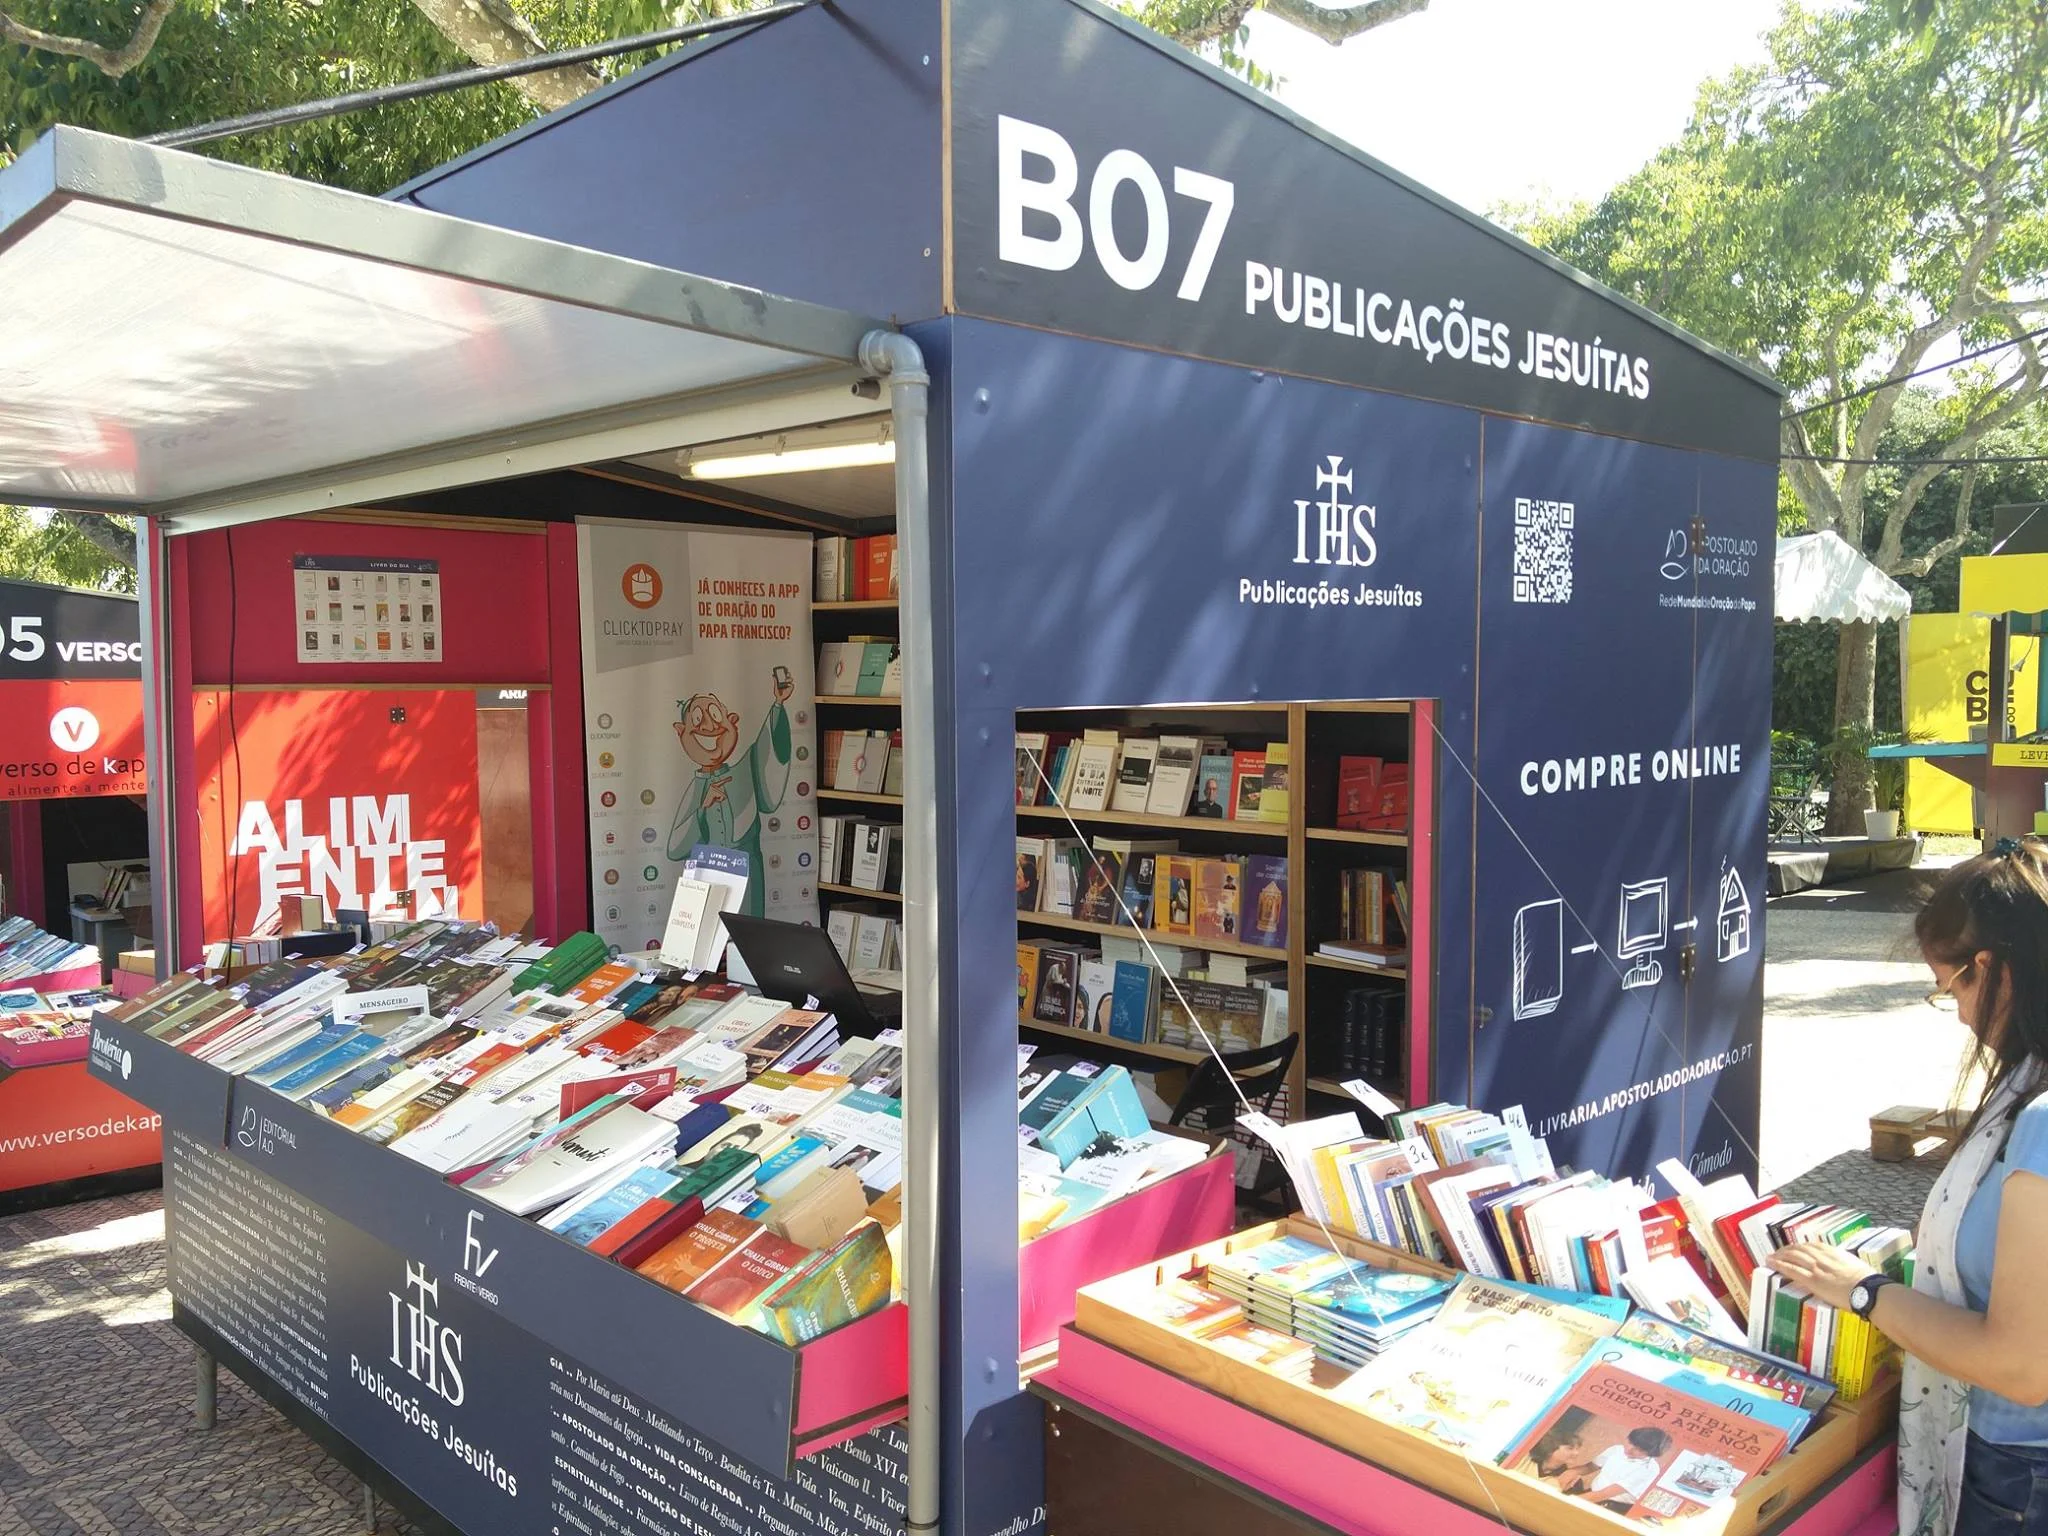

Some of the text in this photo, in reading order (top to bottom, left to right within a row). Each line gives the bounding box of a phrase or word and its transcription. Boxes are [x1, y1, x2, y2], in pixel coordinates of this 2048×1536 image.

[997, 114, 1236, 303] B07
[1245, 261, 1652, 401] PUBLICAÇÕES JESUÍTAS
[1292, 499, 1377, 567] IHS
[1702, 535, 1757, 557] POSTOLADO
[1712, 556, 1750, 579] ORAÇÃO
[697, 577, 800, 598] JÁ CONHECES A APP
[1239, 578, 1423, 609] Publicações Jesuítas
[699, 601, 775, 620] DE ORAÇÃO DO
[603, 619, 684, 637] CLICKTOPRAY
[699, 623, 791, 640] PAPA FRANCISCO?
[66, 755, 96, 775] de
[103, 757, 145, 778] kap
[1520, 744, 1741, 796] COMPRE ONLINE
[8, 782, 145, 796] alimente a mente
[360, 996, 409, 1009] MENSAGEIRO
[263, 1117, 297, 1150] EDITORIAL
[1689, 1140, 1733, 1178] Cómodo
[741, 1261, 775, 1280] O LOUCO
[742, 1248, 791, 1274] KHALIL GIBRAN
[454, 1272, 499, 1306] FRENTE VERSO
[1467, 1293, 1522, 1316] DE JESUS
[1471, 1285, 1553, 1317] O NASCIMENTO
[280, 1320, 320, 1357] ESPIRITUALIDADE
[389, 1291, 465, 1407] IHS
[1589, 1384, 1667, 1420] CHEGOU
[1603, 1378, 1760, 1444] COMO A BÍBLIA
[350, 1353, 518, 1498] Publicações Jesuítas
[550, 1357, 564, 1372] GIA
[588, 1376, 610, 1400] Maria
[611, 1391, 622, 1406] até
[622, 1396, 640, 1418] Deus
[646, 1410, 685, 1445] Meditando
[693, 1437, 714, 1462] Terço
[720, 1454, 751, 1486] Bendita
[752, 1474, 761, 1491] és
[763, 1479, 776, 1500] Tu
[782, 1491, 814, 1525] Maria,
[817, 1512, 839, 1536] Mãe
[574, 1392, 613, 1428] Documentos
[613, 1417, 623, 1432] da
[623, 1422, 644, 1446] Igreja
[654, 1444, 676, 1466] VIDA
[678, 1459, 744, 1508] CONSAGRADA
[845, 1439, 898, 1479] Bento XVI
[554, 1455, 624, 1510] ESPIRITUALIDADE
[562, 1413, 615, 1452] APOSTOLADO
[616, 1445, 628, 1461] DA
[630, 1455, 666, 1485] ORAÇÃO
[700, 1498, 710, 1513] de
[710, 1505, 743, 1534] Registos
[795, 1469, 817, 1495] Vida
[820, 1455, 859, 1488] Vaticano
[600, 1459, 608, 1472] de
[609, 1463, 625, 1486] Fogo
[635, 1484, 678, 1519] CORAÇÃO
[680, 1513, 692, 1529] DE
